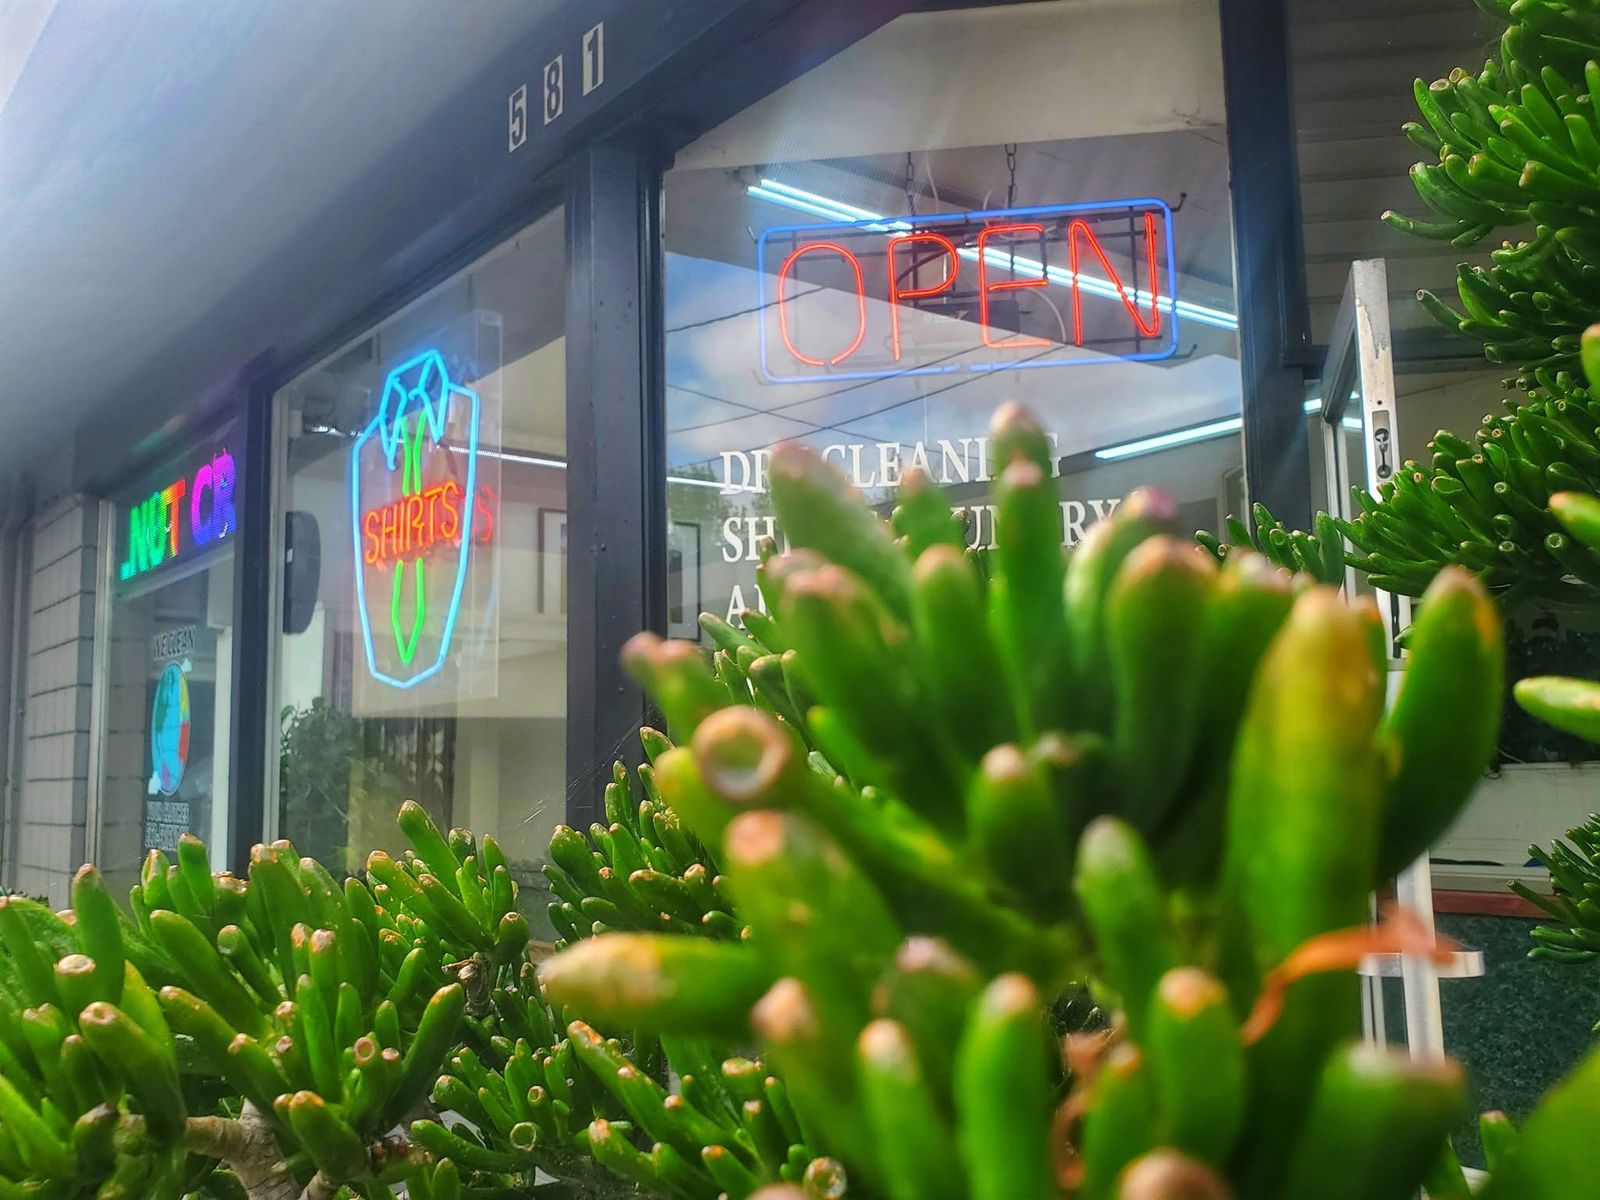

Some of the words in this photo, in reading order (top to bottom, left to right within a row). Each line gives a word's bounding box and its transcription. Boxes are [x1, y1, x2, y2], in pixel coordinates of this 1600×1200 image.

[511, 27, 599, 146] 581
[778, 212, 1160, 367] OPEN
[719, 449, 774, 494] DR
[364, 479, 463, 565] SHIRTS
[168, 624, 197, 658] CLEAN
